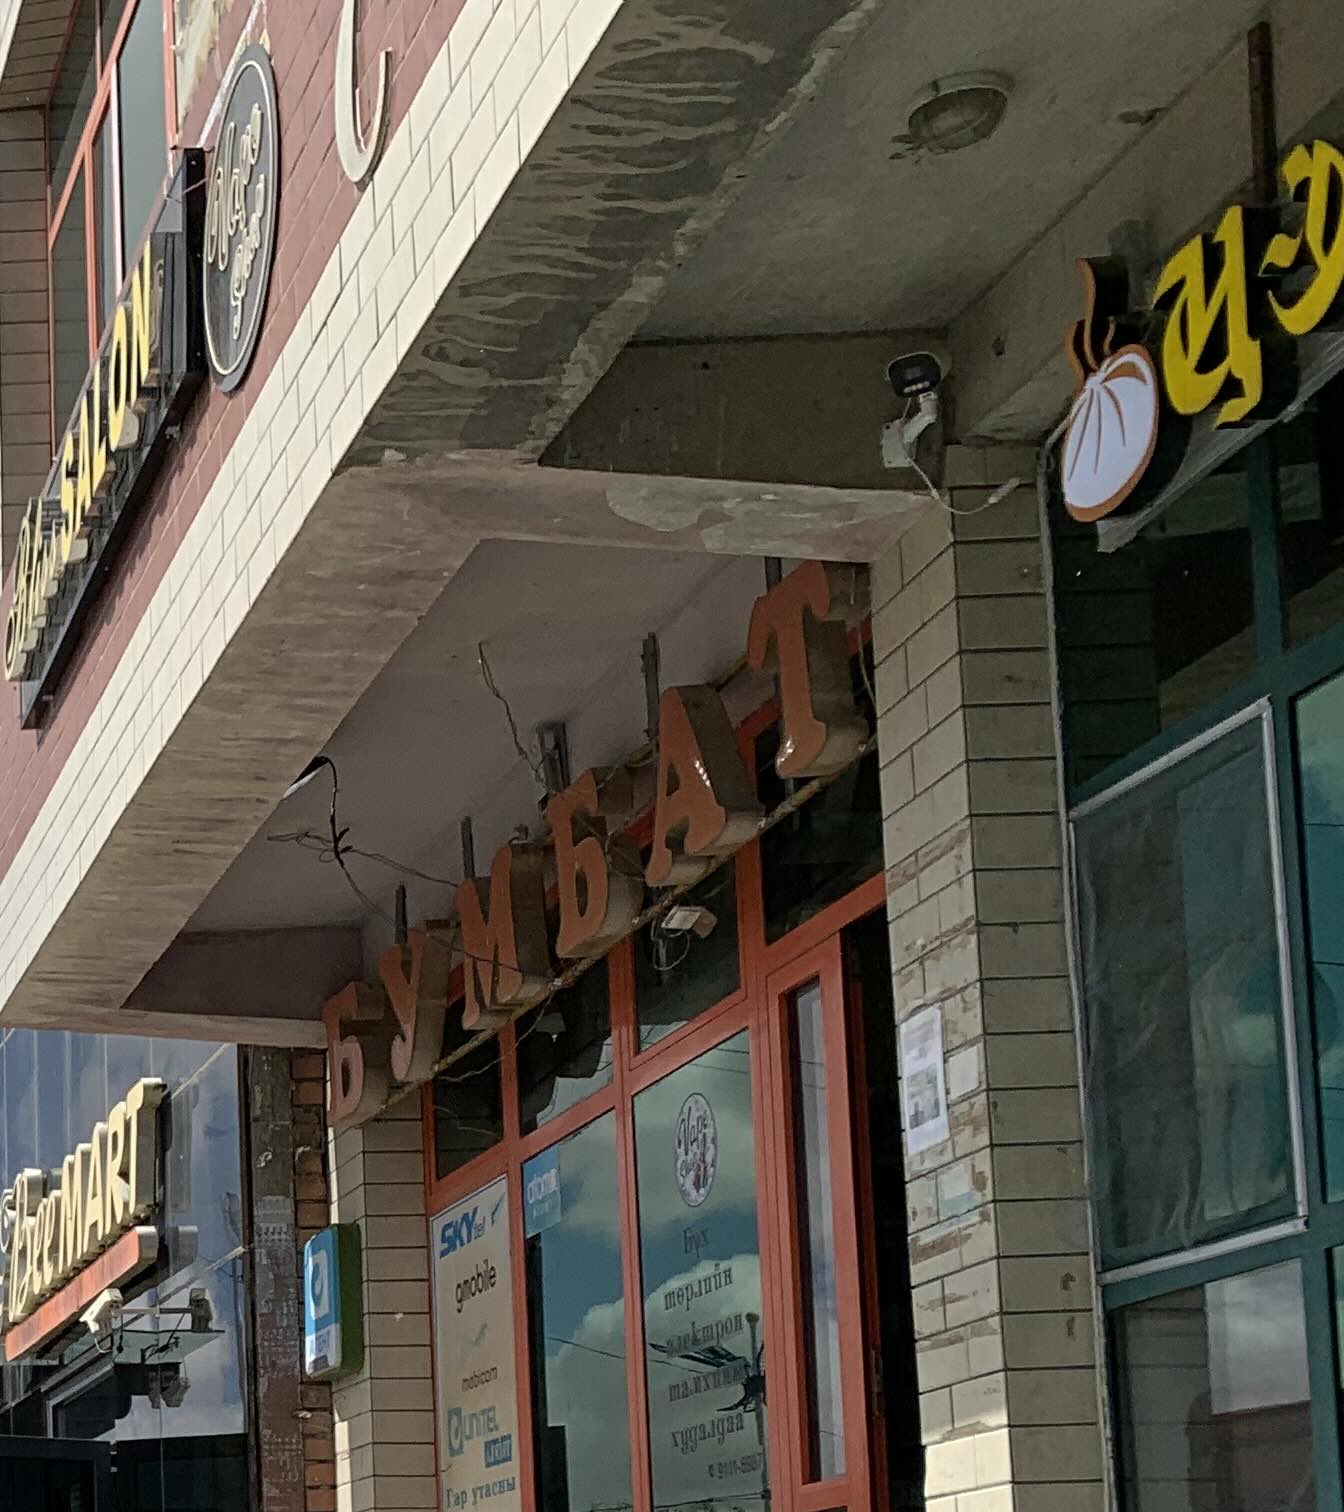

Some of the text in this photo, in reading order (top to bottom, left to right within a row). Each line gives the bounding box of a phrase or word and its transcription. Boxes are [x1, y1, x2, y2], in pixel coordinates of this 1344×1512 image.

[60, 236, 150, 562] SALON
[322, 560, 834, 1128] БУМБАТ
[455, 1258, 497, 1313] gmobile
[446, 1476, 516, 1509] Гар утасны
